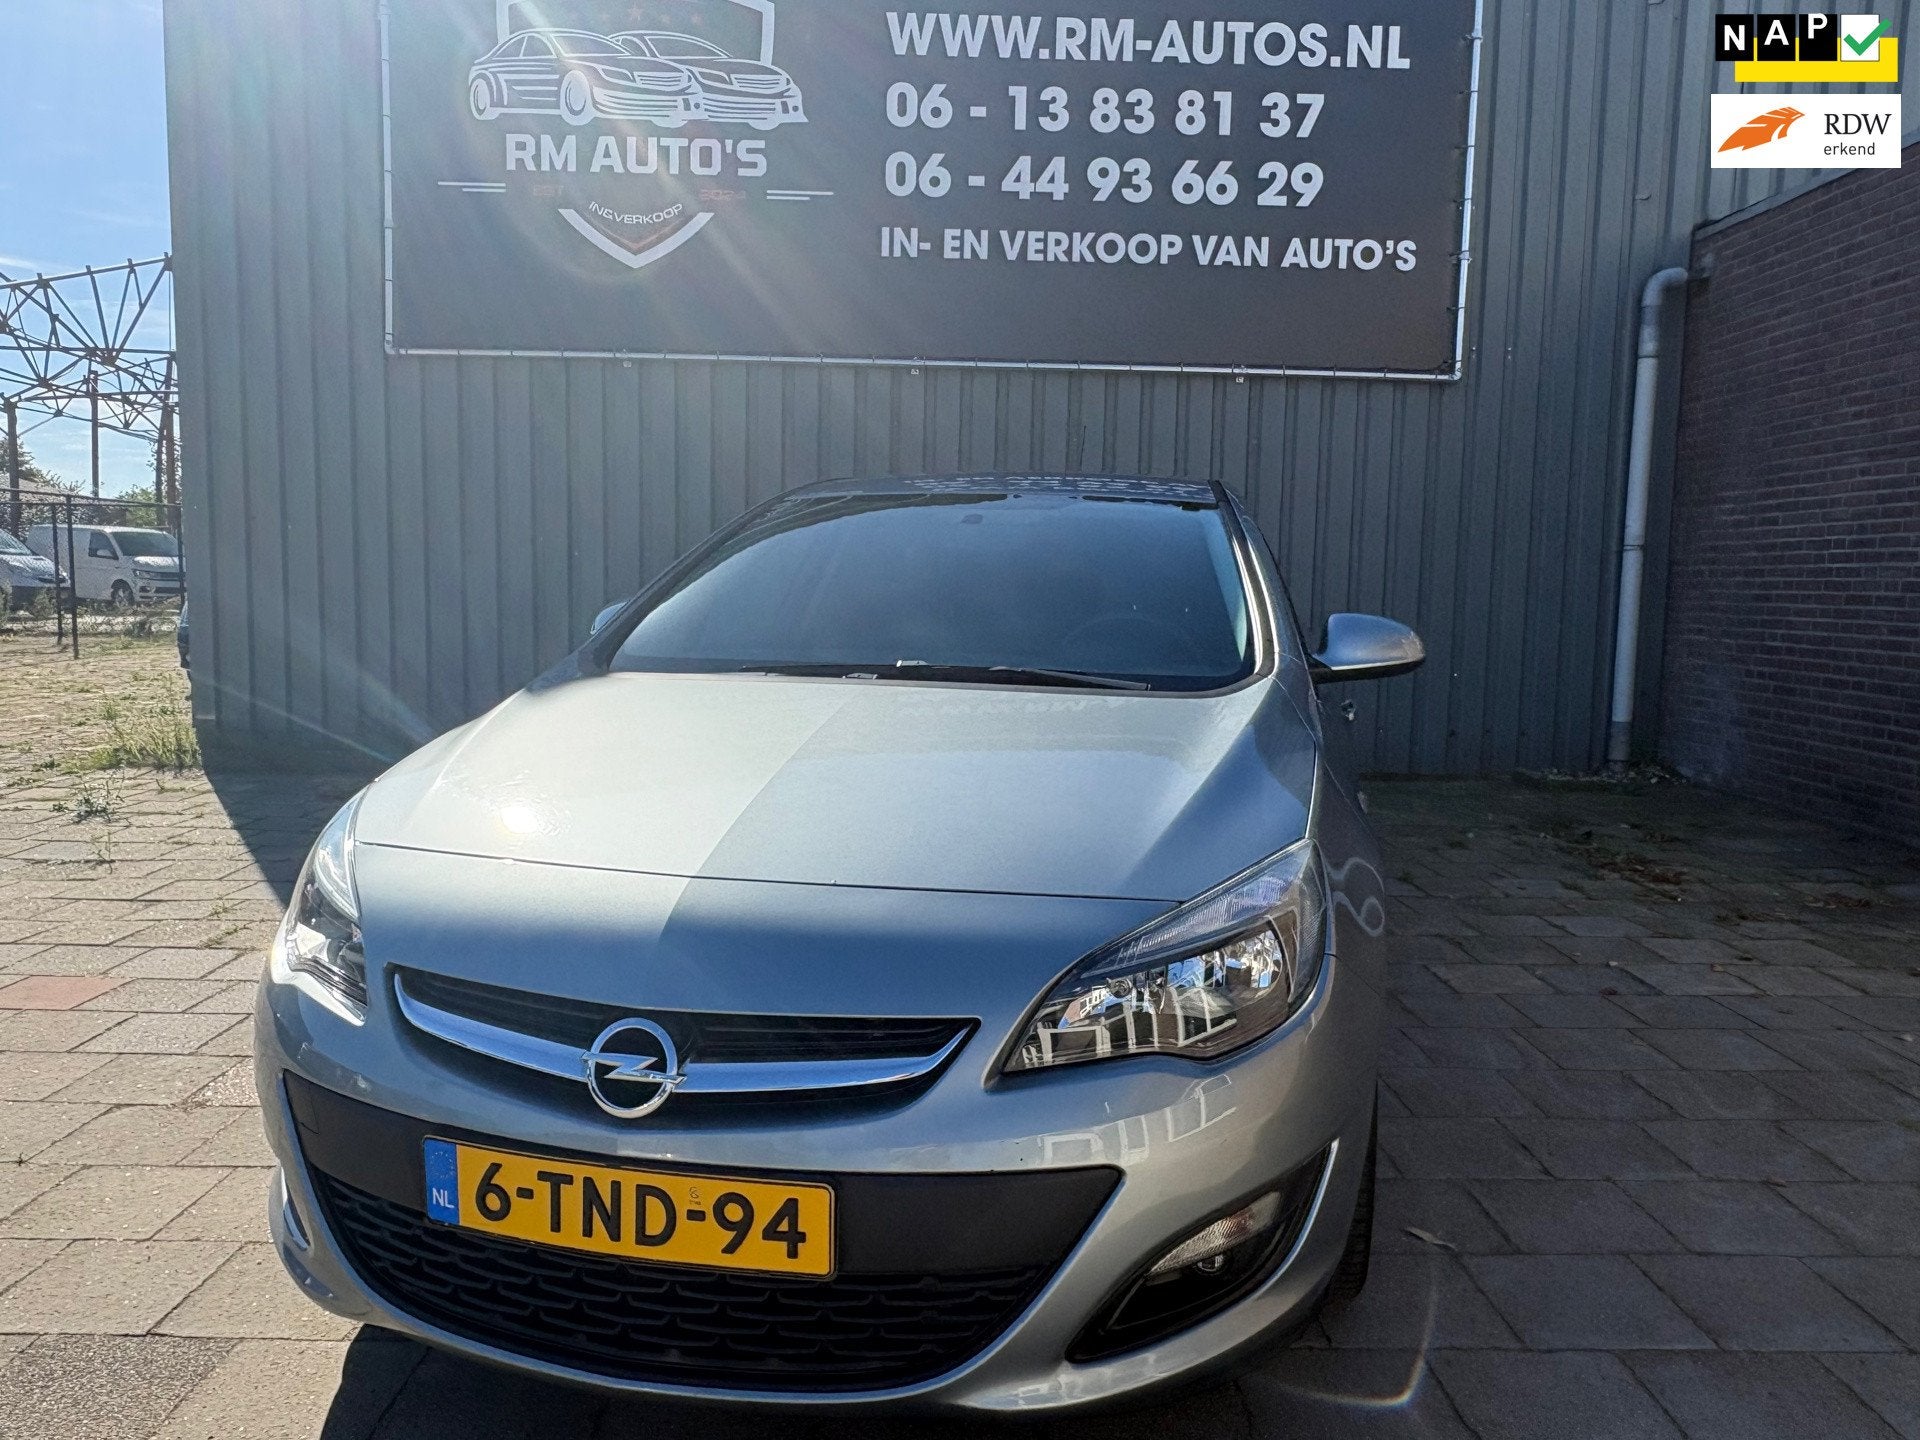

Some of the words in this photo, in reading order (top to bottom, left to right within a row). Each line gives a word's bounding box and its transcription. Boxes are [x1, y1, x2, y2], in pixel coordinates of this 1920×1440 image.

[886, 12, 1411, 69] WWW.RM-AUTOS.NL
[886, 82, 953, 128] 06
[969, 105, 987, 118] -
[1008, 86, 1070, 132] 13
[1089, 87, 1155, 134] 83
[1175, 90, 1233, 135] 81
[1259, 93, 1325, 138] 37
[506, 134, 576, 171] RM
[590, 135, 767, 177] AUTO'S
[885, 151, 952, 197] 06
[968, 175, 986, 187] -
[1001, 155, 1069, 199] 44
[1087, 157, 1153, 202] 93
[1171, 160, 1239, 205] 66
[1257, 162, 1325, 207] 29
[880, 226, 931, 258] IN-
[943, 229, 989, 260] EN
[999, 230, 1183, 265] VERKOOP
[1192, 235, 1270, 267] VAN
[432, 1187, 455, 1209] NL
[475, 1162, 808, 1260] 6-TND-94
